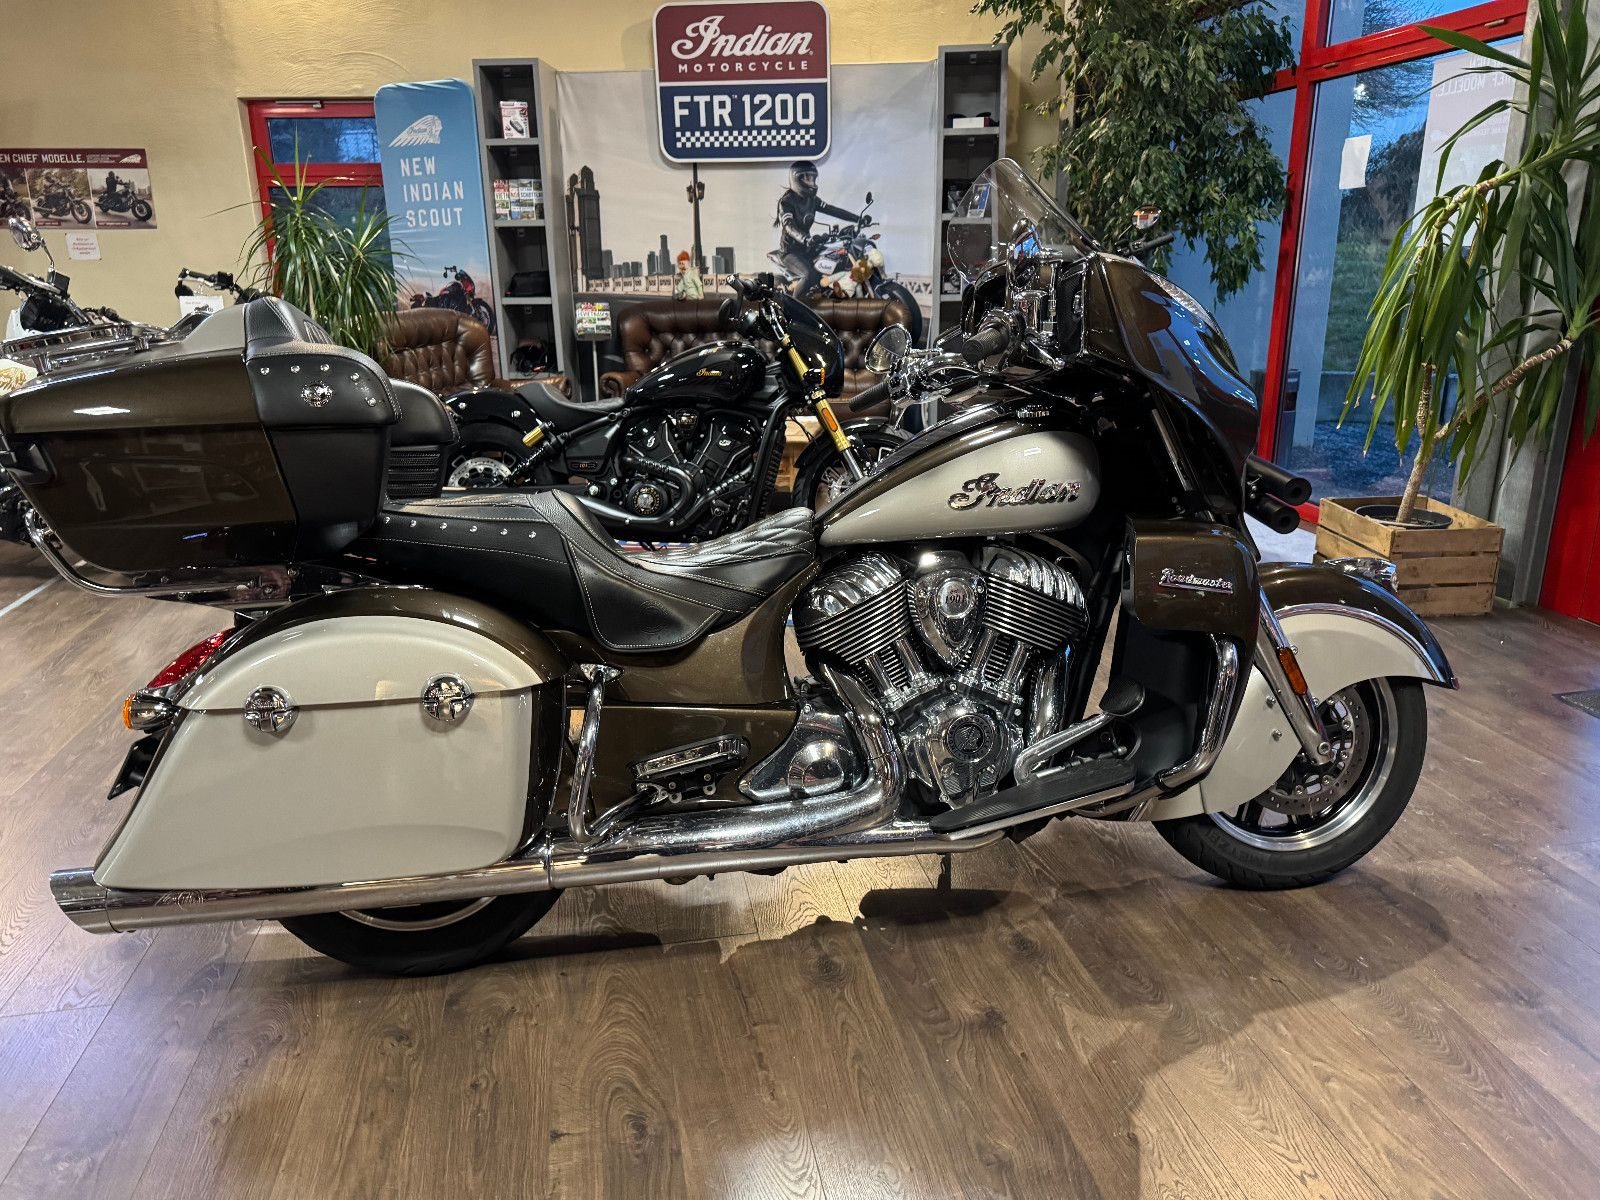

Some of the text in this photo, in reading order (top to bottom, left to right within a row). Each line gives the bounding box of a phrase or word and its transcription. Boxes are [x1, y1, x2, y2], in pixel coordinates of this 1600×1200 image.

[671, 15, 813, 59] Indian
[678, 60, 808, 73] MOTORCYCLE
[742, 92, 816, 127] 1200
[12, 153, 38, 163] CHIEF
[41, 153, 86, 164] MODELLE.
[400, 156, 436, 176] NEW
[403, 181, 464, 203] INDIAN
[406, 207, 463, 228] SCOUT
[948, 472, 1081, 511] Indian
[1160, 567, 1233, 589] Roadmaster
